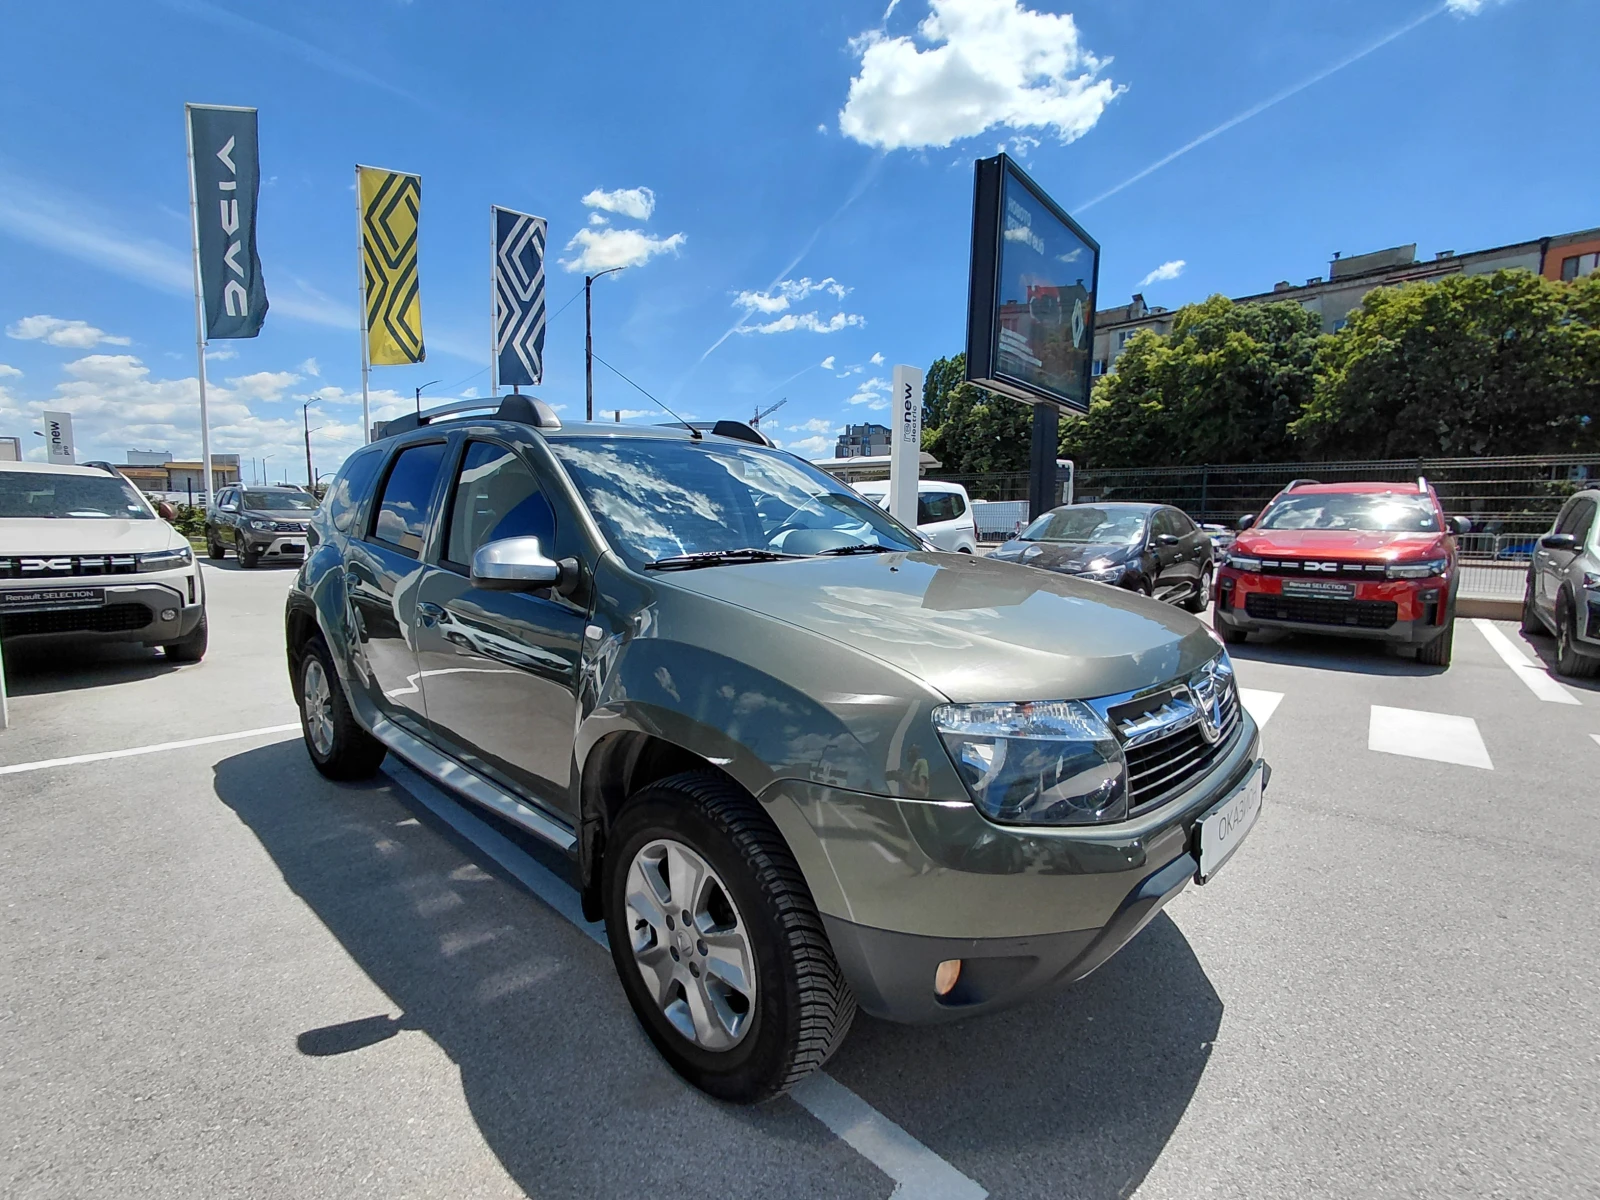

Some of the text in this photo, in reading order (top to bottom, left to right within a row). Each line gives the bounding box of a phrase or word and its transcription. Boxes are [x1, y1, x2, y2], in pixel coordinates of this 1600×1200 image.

[216, 135, 248, 317] DACIA
[5, 590, 94, 601] Renault SELECTION
